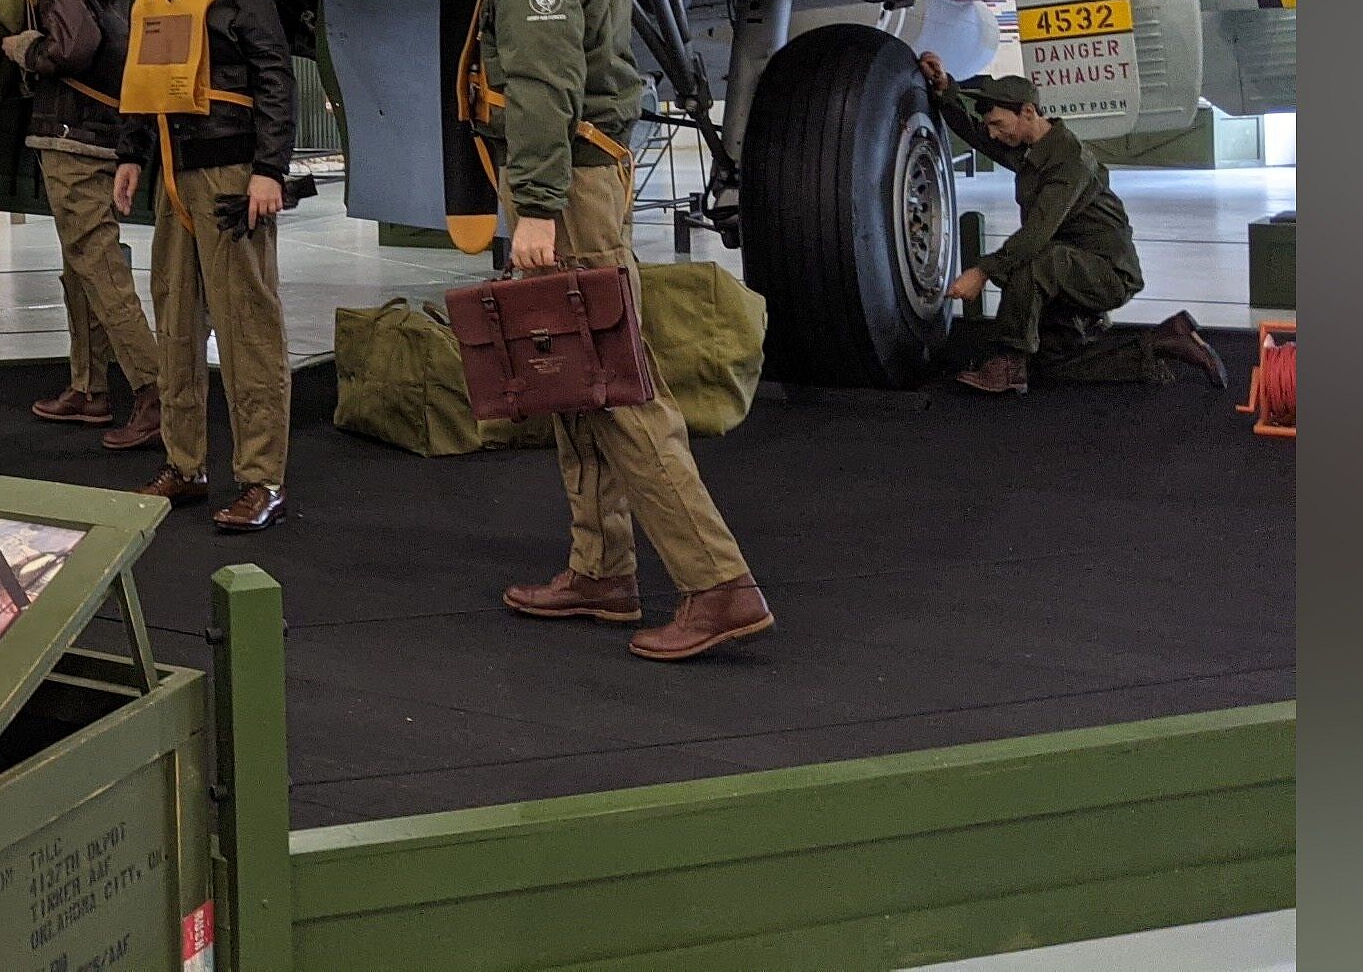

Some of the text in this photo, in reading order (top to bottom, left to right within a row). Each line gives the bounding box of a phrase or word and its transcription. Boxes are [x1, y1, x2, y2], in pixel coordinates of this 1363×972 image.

[1037, 4, 1115, 35] 4532
[1034, 39, 1120, 64] DANGER
[1030, 62, 1130, 88] EXHAUST
[1061, 102, 1086, 114] NOT
[1090, 99, 1128, 111] PUSH
[30, 855, 112, 923] TINKER AAF
